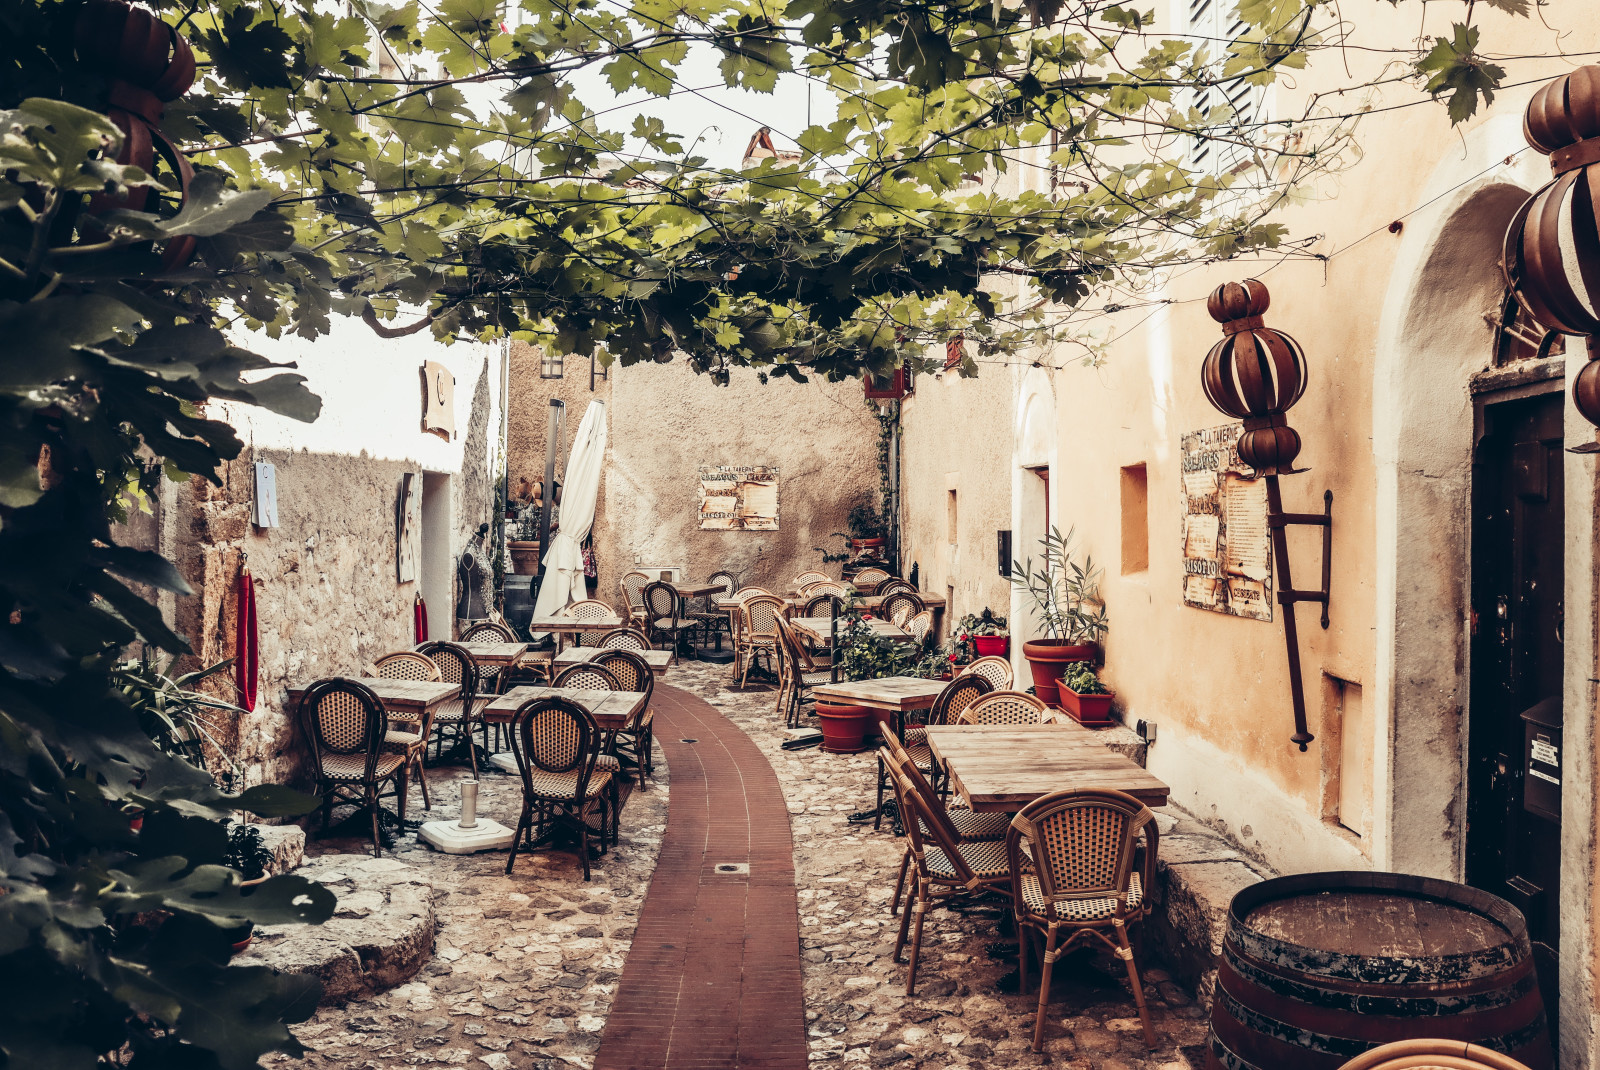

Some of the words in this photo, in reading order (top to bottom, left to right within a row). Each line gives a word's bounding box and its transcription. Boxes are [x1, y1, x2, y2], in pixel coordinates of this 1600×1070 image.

[1204, 431, 1212, 446] LA
[1213, 427, 1238, 444] TAVERNE
[1186, 560, 1216, 575] RISOTTO
